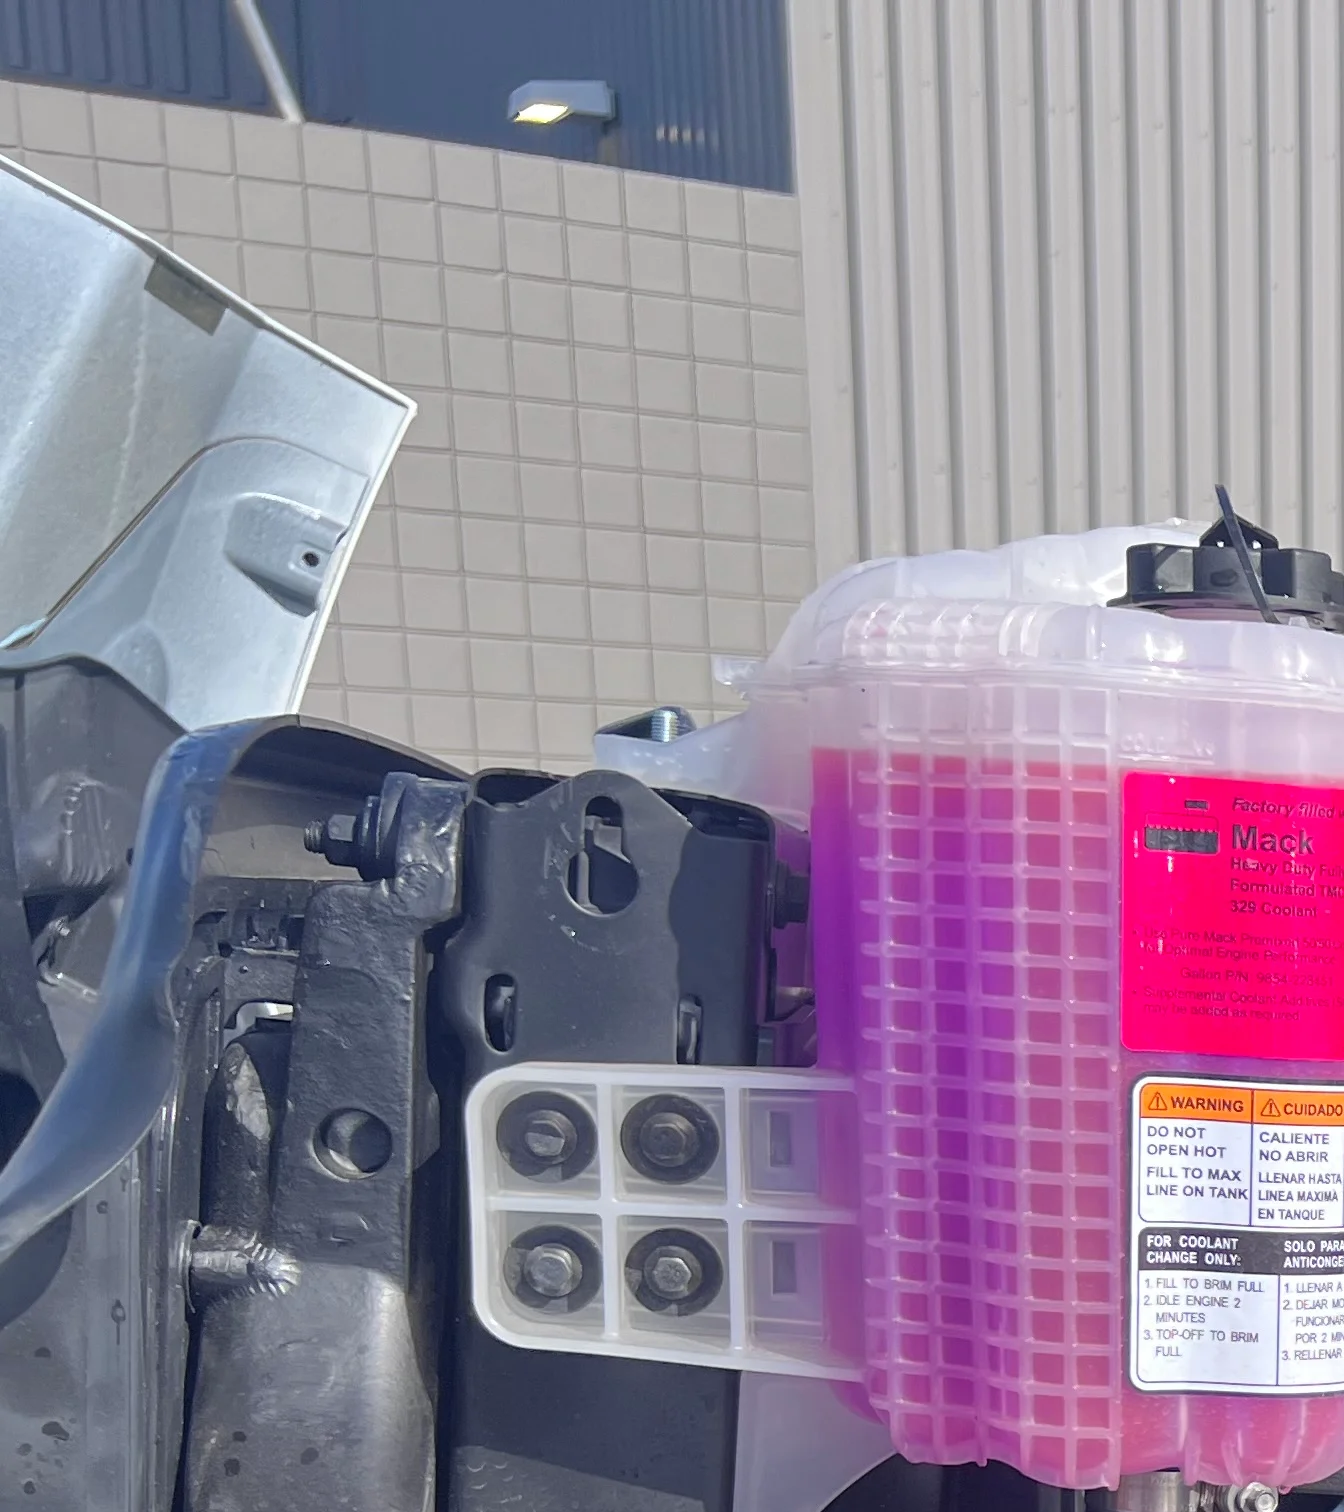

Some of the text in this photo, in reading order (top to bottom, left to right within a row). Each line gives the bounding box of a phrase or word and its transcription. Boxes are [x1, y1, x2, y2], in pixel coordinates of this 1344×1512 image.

[1232, 797, 1294, 818] Factory
[1298, 803, 1335, 819] filled
[1232, 824, 1315, 855] Mack
[1231, 858, 1278, 875] Heavy
[1283, 861, 1315, 880] Duty
[1231, 879, 1315, 898] Formulated
[1320, 884, 1344, 898] TMC
[1231, 900, 1317, 918] 329 Coolant
[1171, 929, 1237, 944] Pure Mack
[1165, 943, 1213, 960] Optimal
[1216, 948, 1260, 962] Engine
[1181, 967, 1220, 981] Gallon
[1225, 970, 1249, 984] P/N
[1144, 987, 1226, 1004] Supplemental
[1231, 991, 1276, 1005] Coolant
[1172, 1003, 1187, 1015] be
[1191, 1004, 1227, 1020] added
[1233, 1008, 1247, 1020] as
[1250, 1006, 1299, 1022] required
[1171, 1095, 1244, 1113] WARNING
[1284, 1102, 1343, 1117] CUIDADO
[1147, 1126, 1206, 1139] DO NOT
[1259, 1132, 1329, 1145] CALIENTE
[1147, 1144, 1227, 1159] OPEN HOT
[1259, 1150, 1328, 1163] NO ABRIR
[1147, 1167, 1241, 1182] FILL TO MAX
[1259, 1172, 1342, 1185] LLENAR HASTA
[1146, 1185, 1248, 1201] LINE ON TANK
[1258, 1190, 1338, 1202] LINEA MAXIMA
[1258, 1208, 1325, 1221] EN TANQUE
[1147, 1235, 1239, 1250] FOR COOLANT
[1284, 1239, 1344, 1253] SOLO PARA
[1146, 1251, 1241, 1266] CHANGE ONLY:
[1145, 1278, 1264, 1292] 1. FILL TO BRIM FULL
[1296, 1282, 1334, 1293] LLENAR
[1336, 1281, 1342, 1292] A
[1144, 1295, 1241, 1308] 2. IDLE ENGINE 2
[1296, 1298, 1328, 1310] DEJAR
[1156, 1312, 1205, 1323] MINUTES
[1295, 1314, 1344, 1327] FUNCIONAR
[1144, 1329, 1259, 1343] 3. TOP-OFF TO BRIM
[1295, 1333, 1318, 1344] POR
[1321, 1332, 1327, 1343] 2
[1156, 1346, 1182, 1357] FULL
[1294, 1348, 1342, 1361] RELLENAR
